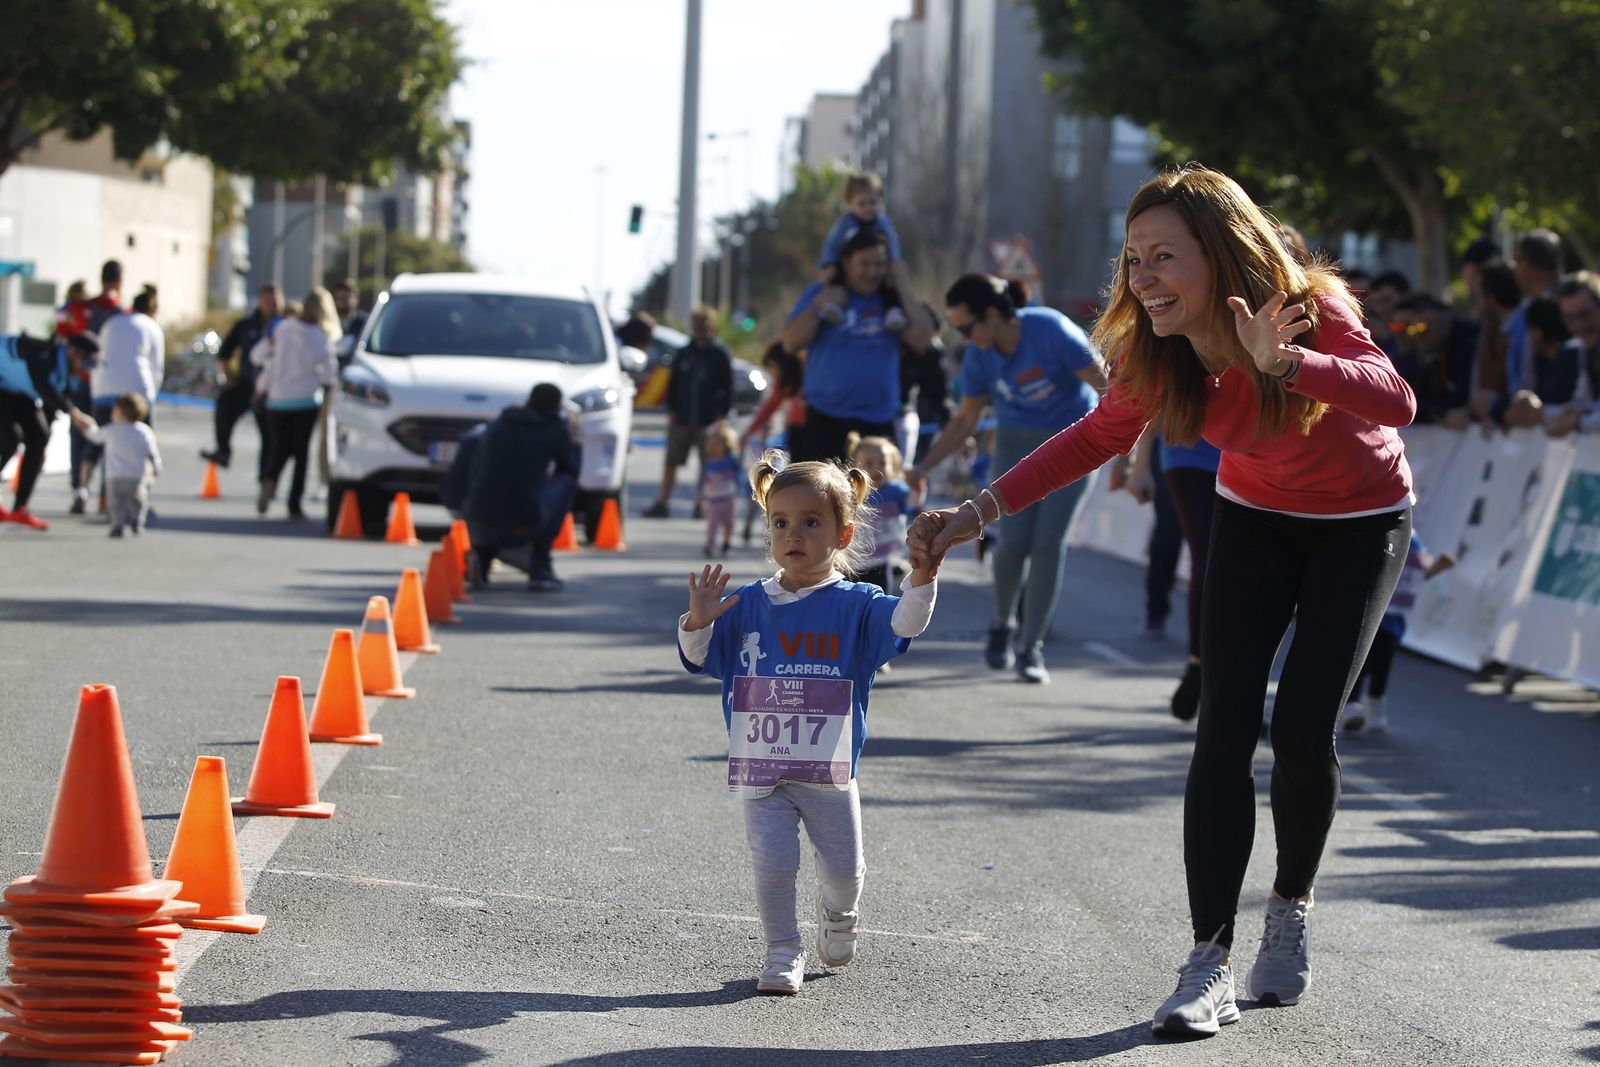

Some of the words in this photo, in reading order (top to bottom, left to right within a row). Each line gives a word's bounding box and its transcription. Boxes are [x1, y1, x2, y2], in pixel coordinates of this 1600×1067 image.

[778, 632, 839, 659] VIII
[775, 664, 841, 677] CARRERA
[782, 680, 804, 690] VIII
[747, 714, 828, 745] 3017
[770, 746, 791, 755] ANA
